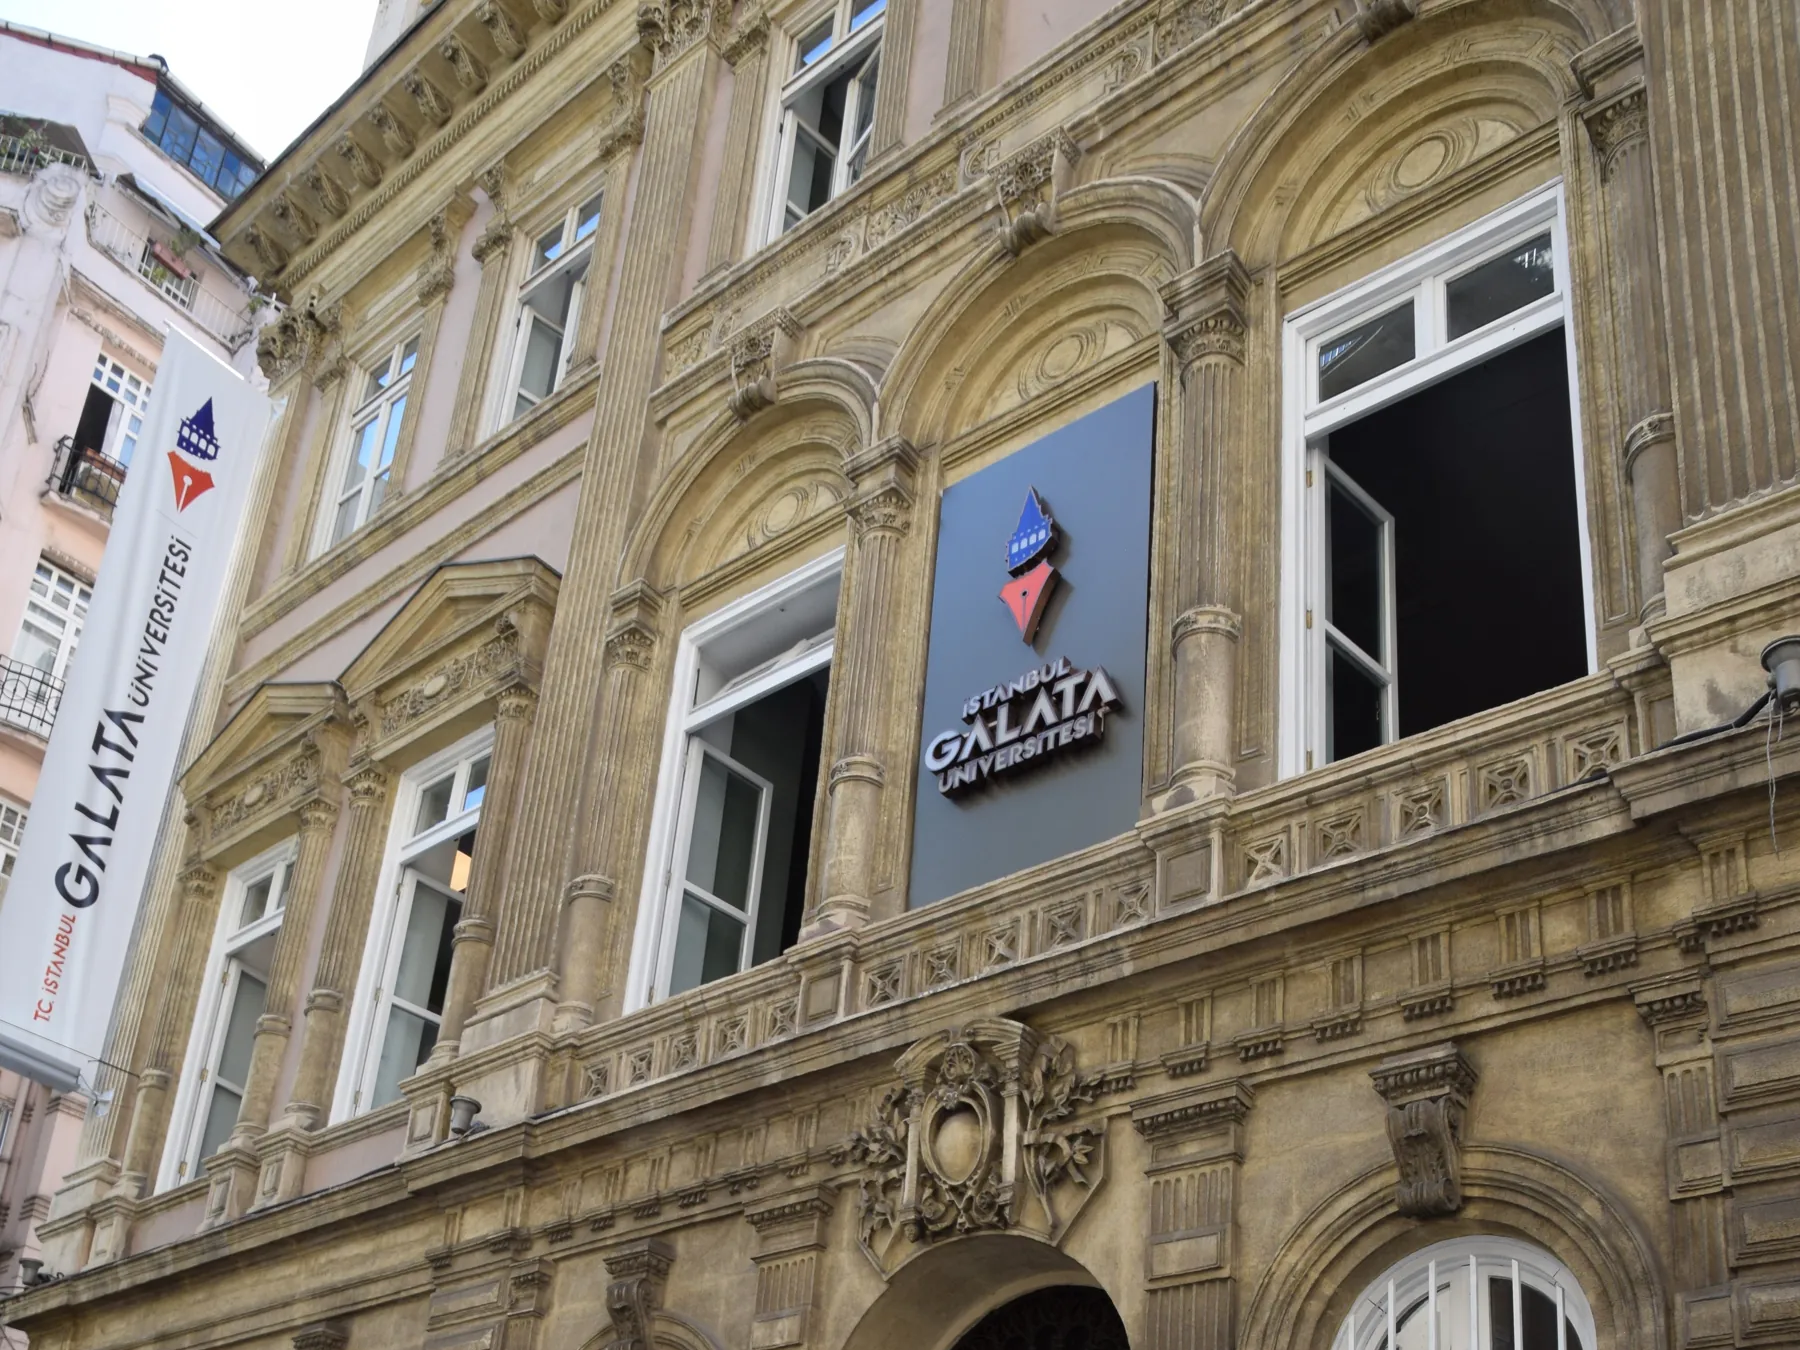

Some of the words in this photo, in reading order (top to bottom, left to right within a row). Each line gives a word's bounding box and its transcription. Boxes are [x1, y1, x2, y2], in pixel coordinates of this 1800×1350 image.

[127, 535, 193, 707] ÜNİVERSİTESİ
[925, 664, 1118, 771] GALATA
[55, 708, 145, 908] GALATA
[41, 914, 76, 995] İSTANBUL
